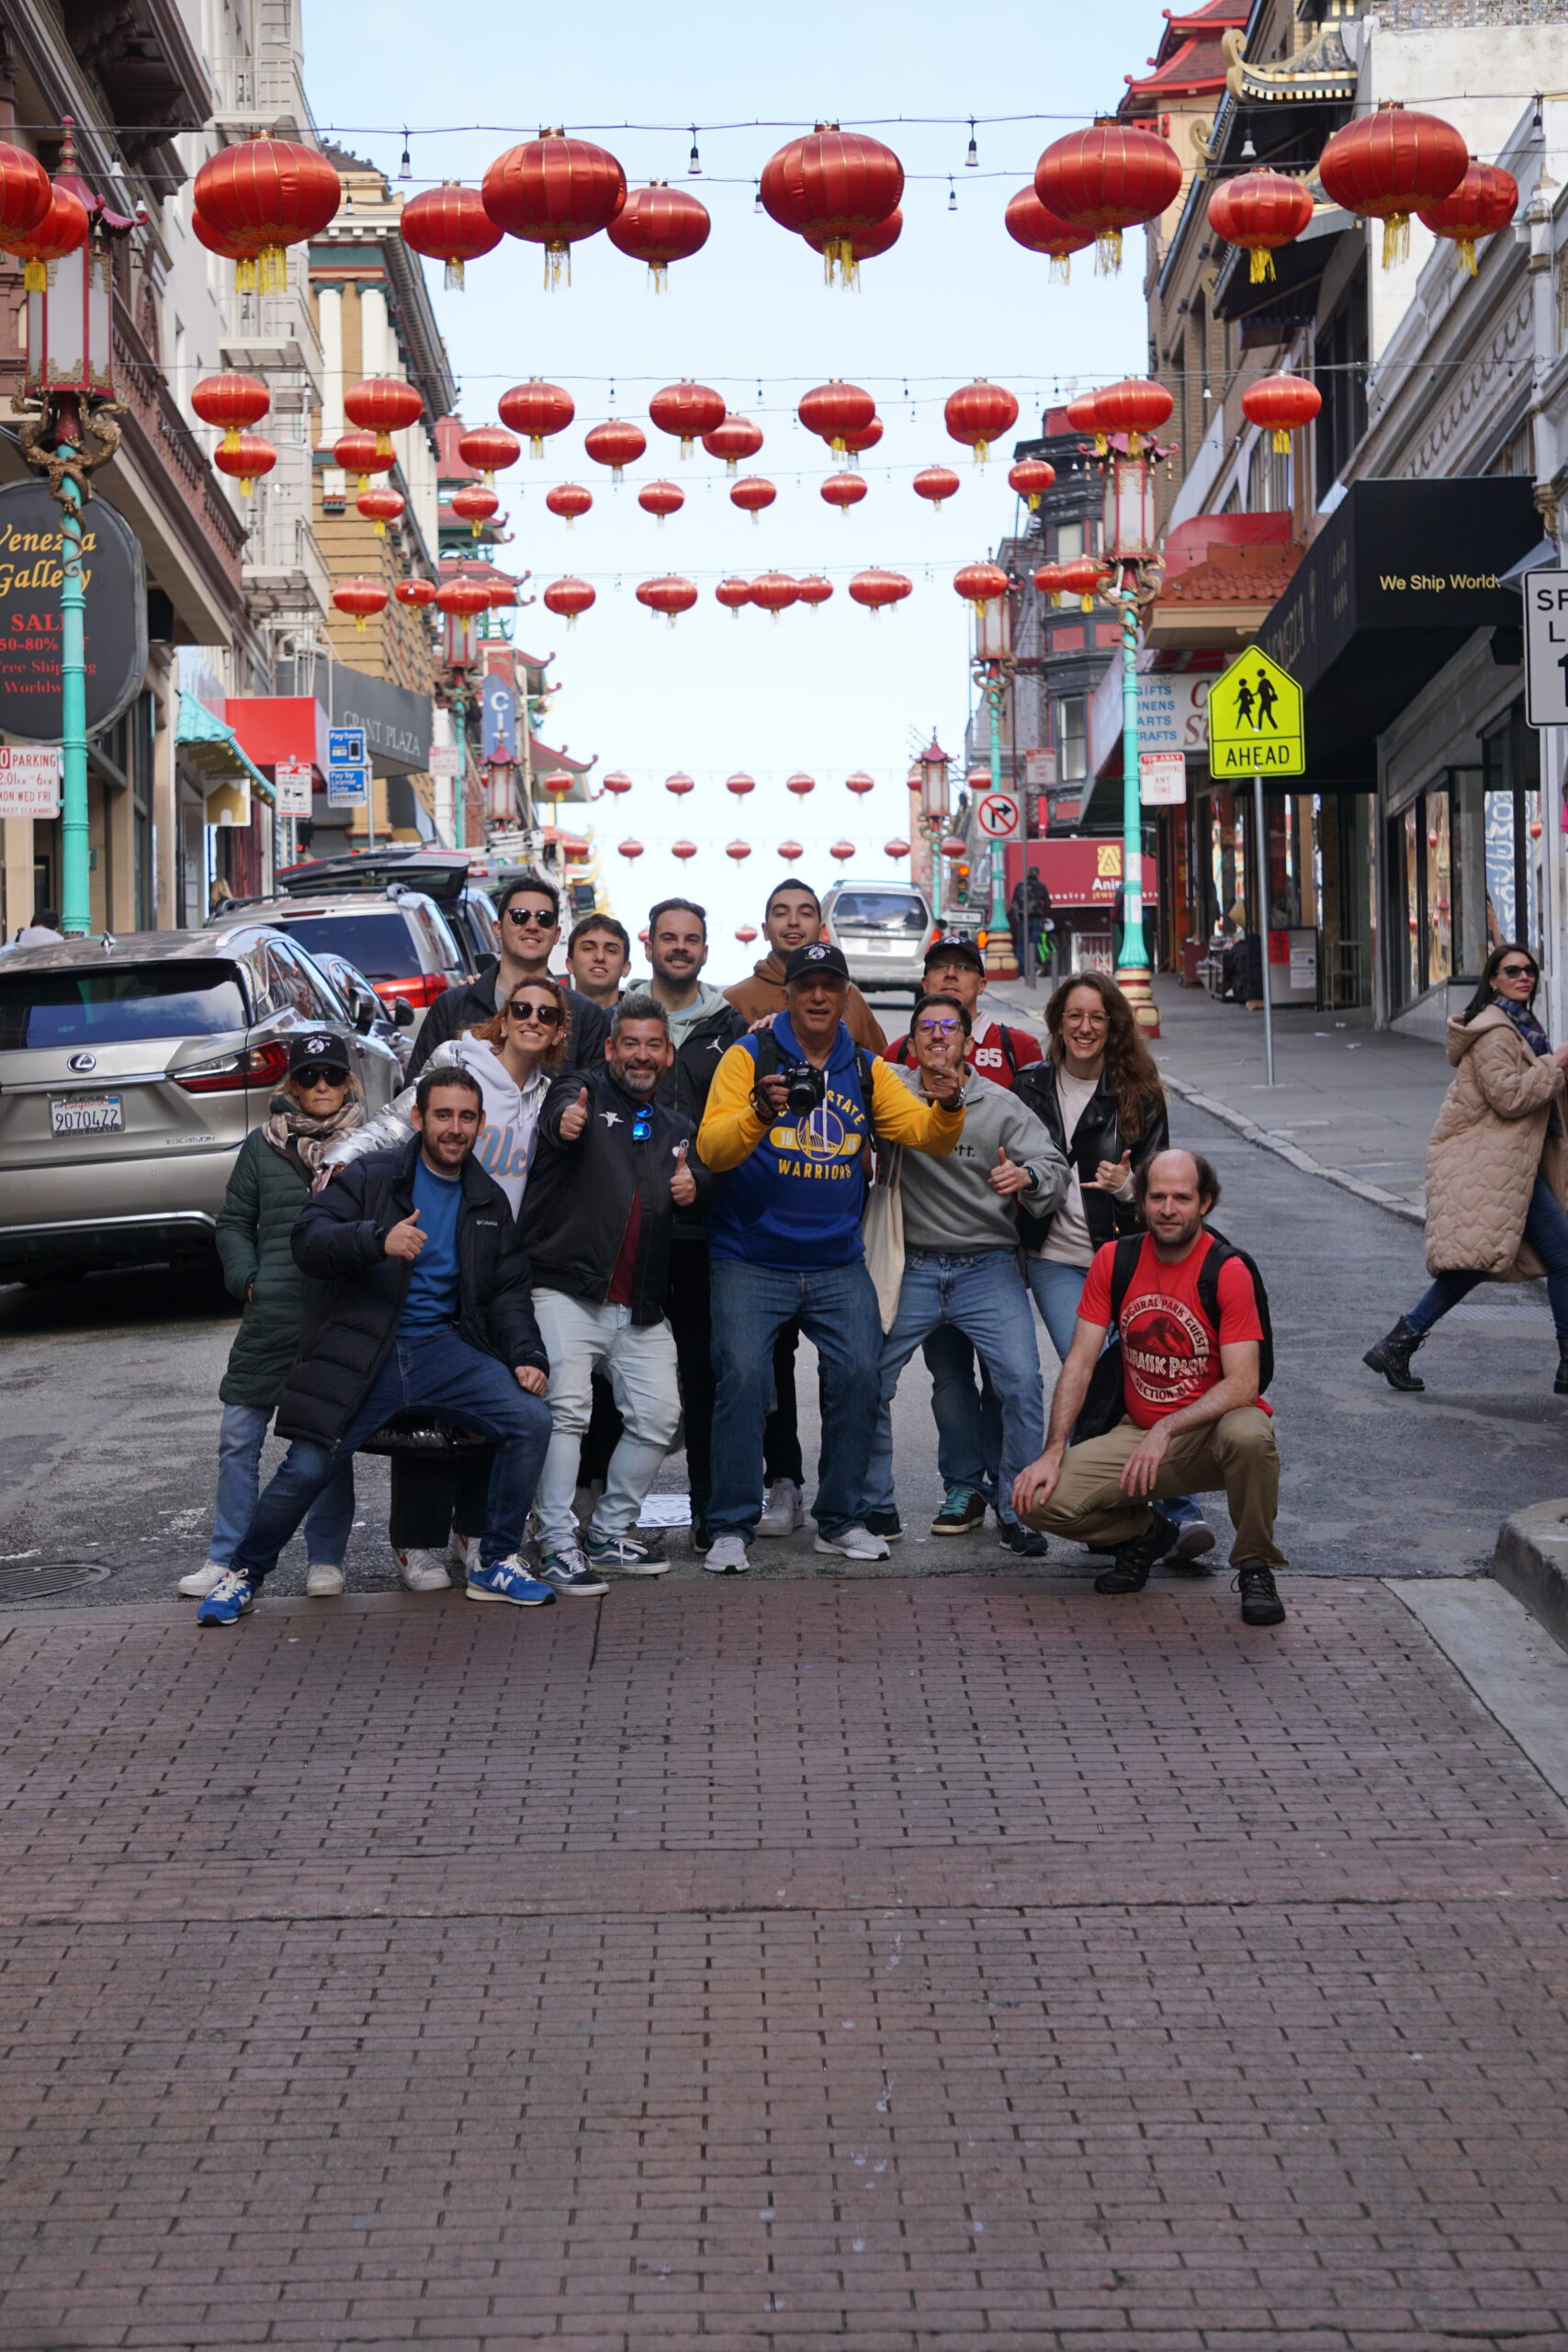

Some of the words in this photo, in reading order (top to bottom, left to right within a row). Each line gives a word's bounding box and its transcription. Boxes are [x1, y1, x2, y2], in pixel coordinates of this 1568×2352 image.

[0, 524, 96, 551] Veneza
[0, 560, 92, 596] Galley
[1380, 575, 1406, 591] We
[1410, 574, 1446, 593] Ship
[11, 614, 64, 632] SAL
[1137, 701, 1176, 711] INENS
[1136, 715, 1172, 726] ARTS
[331, 732, 344, 741] Pay
[344, 731, 362, 740] here
[386, 725, 421, 757] PLAZA
[1139, 730, 1177, 741] RAFTS
[12, 753, 56, 768] PARKING
[1225, 745, 1291, 767] AHEAD
[17, 790, 35, 802] WED
[38, 790, 51, 802] FRI
[974, 1047, 1003, 1068] 85
[827, 1089, 865, 1125] STATE
[778, 1159, 852, 1180] WARRIORS
[1162, 1298, 1186, 1318] PARK
[1186, 1317, 1206, 1349] GUEST
[1169, 1355, 1209, 1379] PARK
[1134, 1377, 1174, 1401] SECTION
